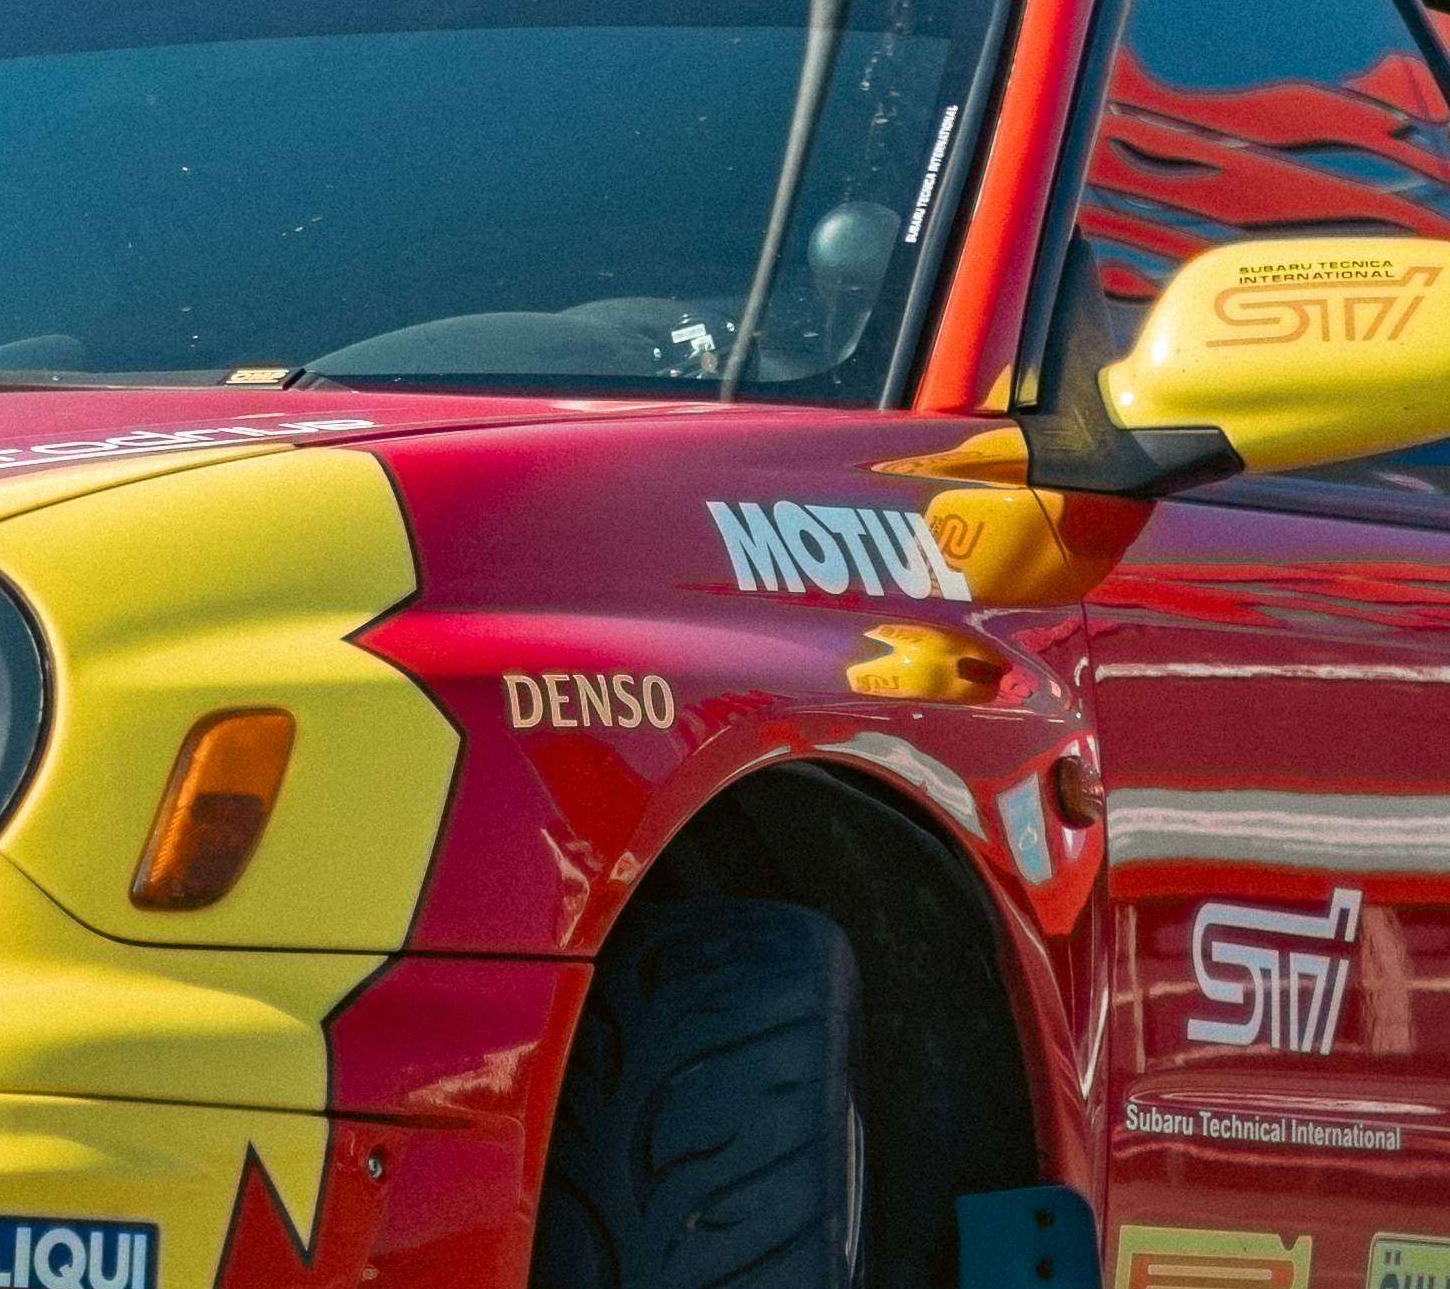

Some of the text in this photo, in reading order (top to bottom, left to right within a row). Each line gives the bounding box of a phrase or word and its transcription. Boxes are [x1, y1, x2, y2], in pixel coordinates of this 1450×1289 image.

[1238, 268, 1395, 285] INTERNATIONAL
[1239, 260, 1394, 275] SUBARU TECNICA
[705, 500, 972, 601] MOTUL
[504, 672, 675, 730] DENSO
[1126, 1105, 1401, 1150] Subaru Technical International
